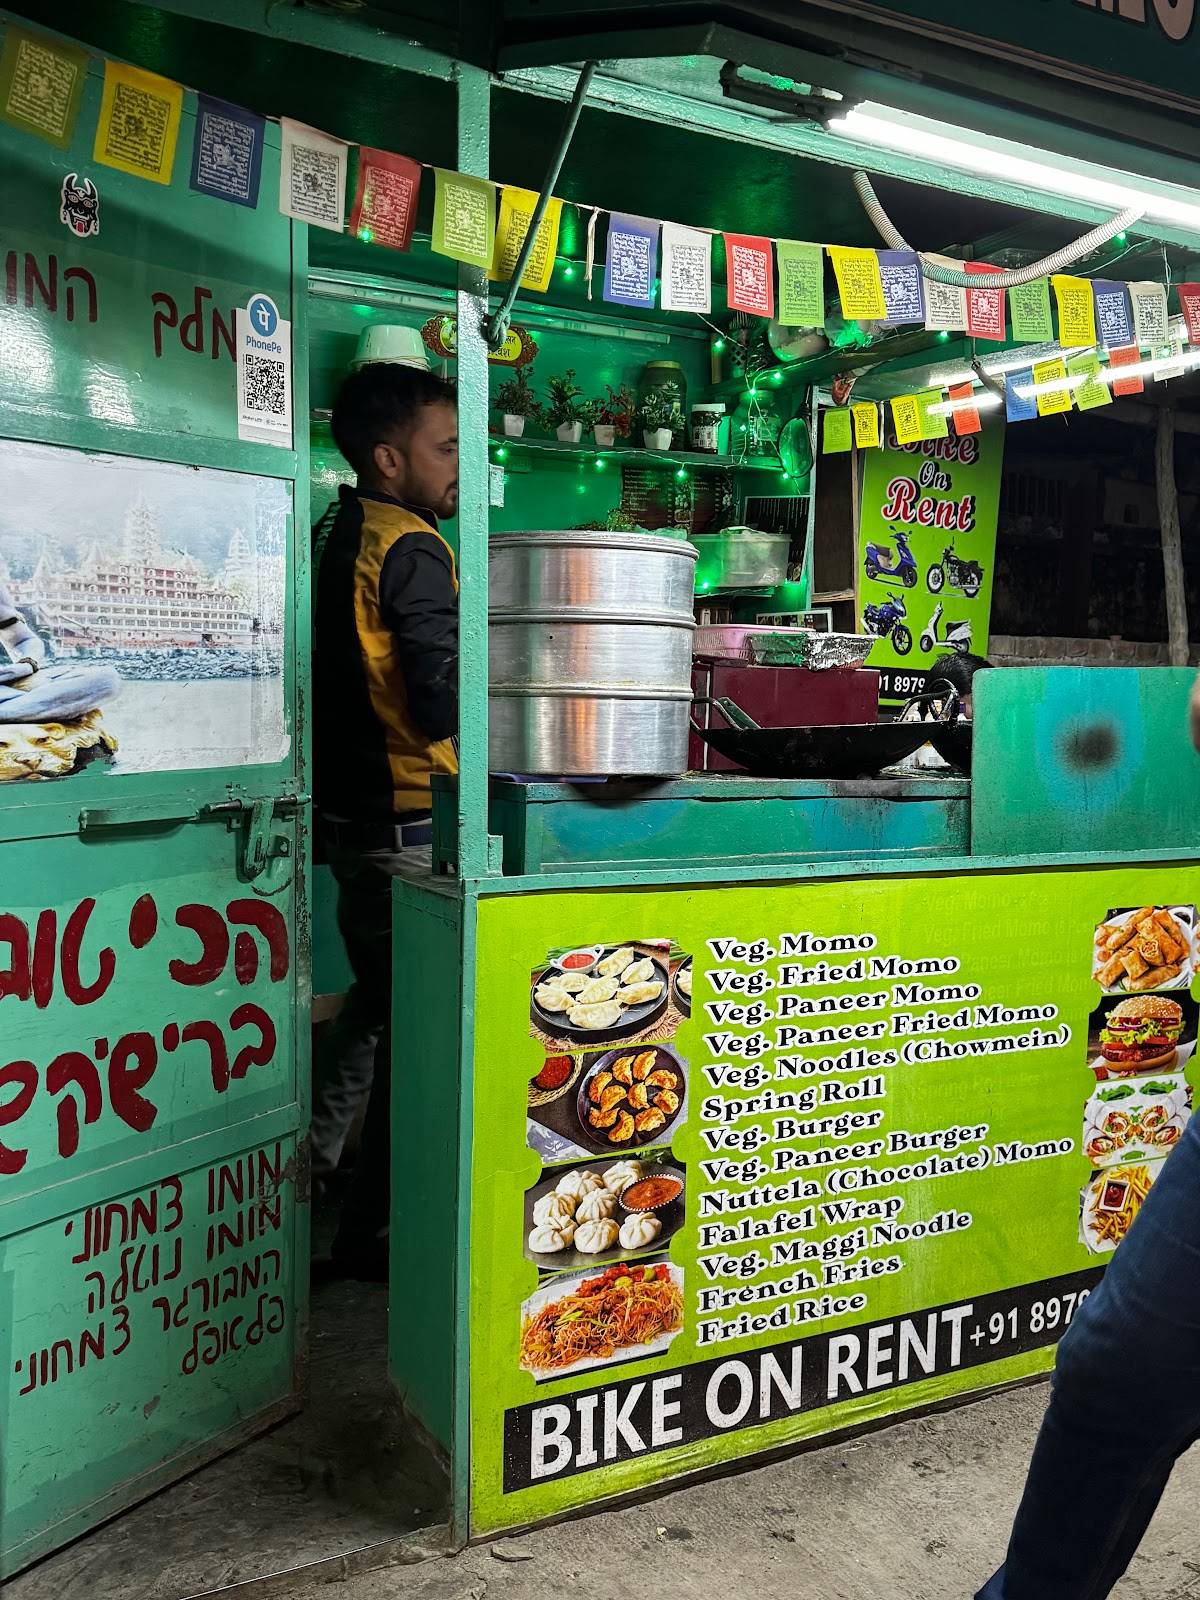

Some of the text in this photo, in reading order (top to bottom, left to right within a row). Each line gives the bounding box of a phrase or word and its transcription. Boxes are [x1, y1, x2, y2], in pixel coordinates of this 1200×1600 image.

[246, 335, 282, 354] PhonePe
[919, 461, 948, 490] On
[882, 477, 975, 532] Rent
[129, 893, 289, 986] הכי
[709, 934, 874, 963] Veg. Momo
[709, 958, 958, 994] Veg. Fried Momo
[707, 1003, 771, 1025] Veg.
[780, 993, 887, 1016] Paneer
[894, 985, 979, 1005] Momo
[706, 1006, 1056, 1057] Veg. Paneer Fried Momo
[706, 1025, 1069, 1088] Veg. Noodles (Chowmein)
[703, 1089, 815, 1122] Spring
[822, 1077, 883, 1102] Roll
[702, 1126, 987, 1182] Veg. Paneer Burger
[704, 1112, 881, 1151] Veg. Burger
[702, 1140, 1072, 1215] Nuttela (Chocolate) Momo
[701, 1199, 901, 1247] Falafel Wrap
[701, 1212, 970, 1277] Veg. Maggi Noodle
[84, 1237, 182, 1314] נוטלה
[152, 1249, 281, 1331] המבורגר
[700, 1258, 900, 1312] French Fries
[699, 1296, 864, 1344] Fried Rice
[531, 1374, 682, 1479] BIKE
[706, 1346, 802, 1428] ON
[828, 1304, 973, 1399] RENT
[970, 1307, 1018, 1347] +91
